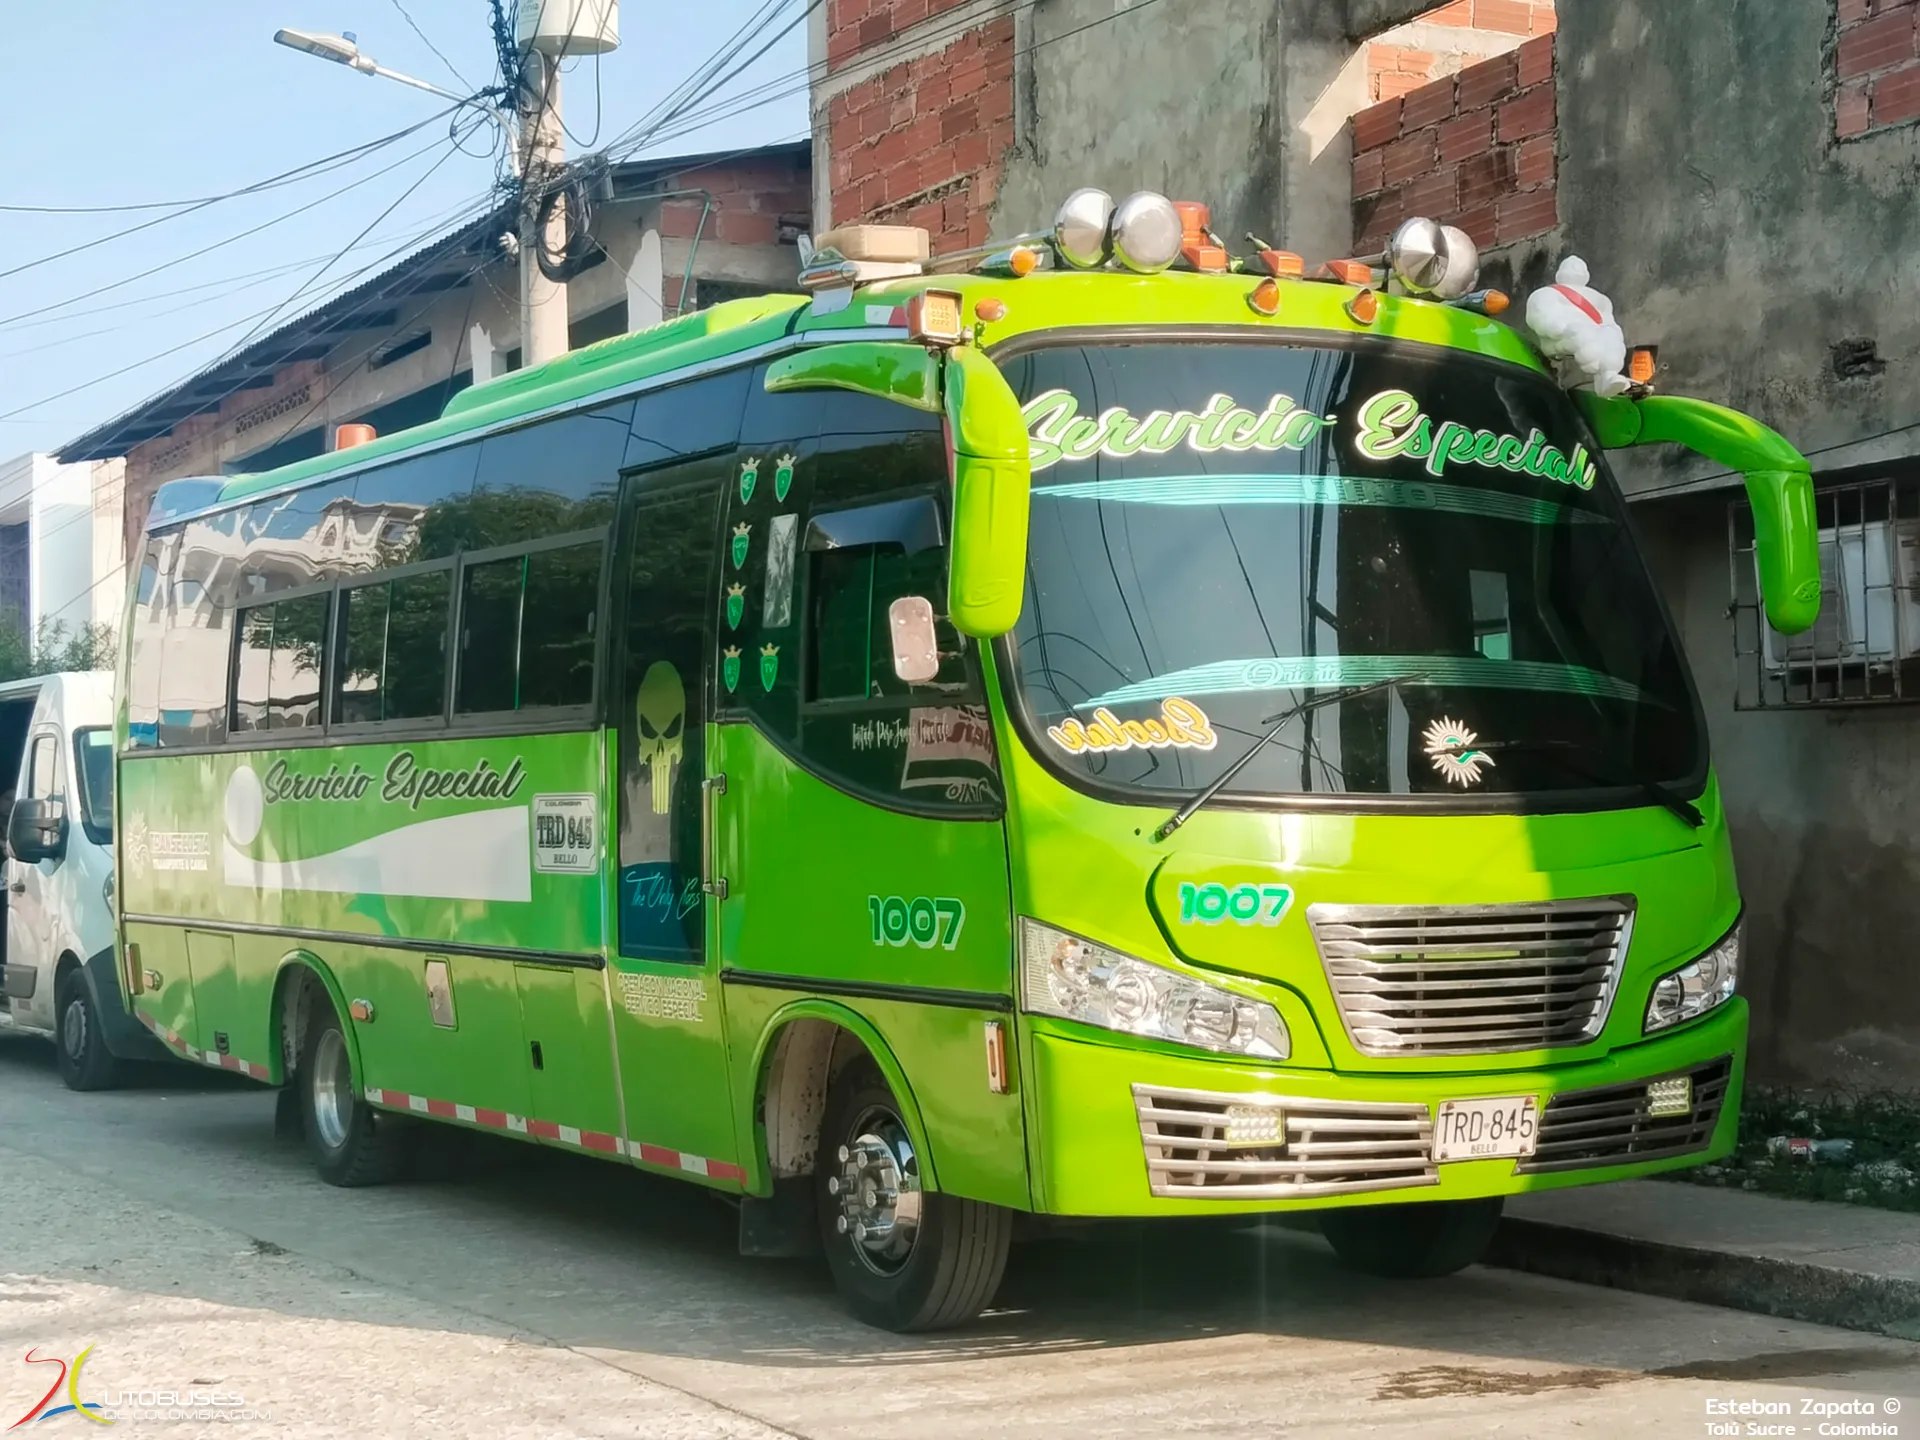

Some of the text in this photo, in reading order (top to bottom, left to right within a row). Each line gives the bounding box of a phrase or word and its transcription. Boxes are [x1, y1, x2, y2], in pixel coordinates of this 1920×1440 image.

[1020, 388, 1596, 490] Servicio Especial
[265, 751, 527, 810] Servicio Especial
[537, 815, 593, 850] TRD 845
[553, 854, 578, 864] BELLO
[868, 895, 966, 950] 1007
[1178, 882, 1295, 927] 1007
[1471, 1143, 1498, 1154] BELLO
